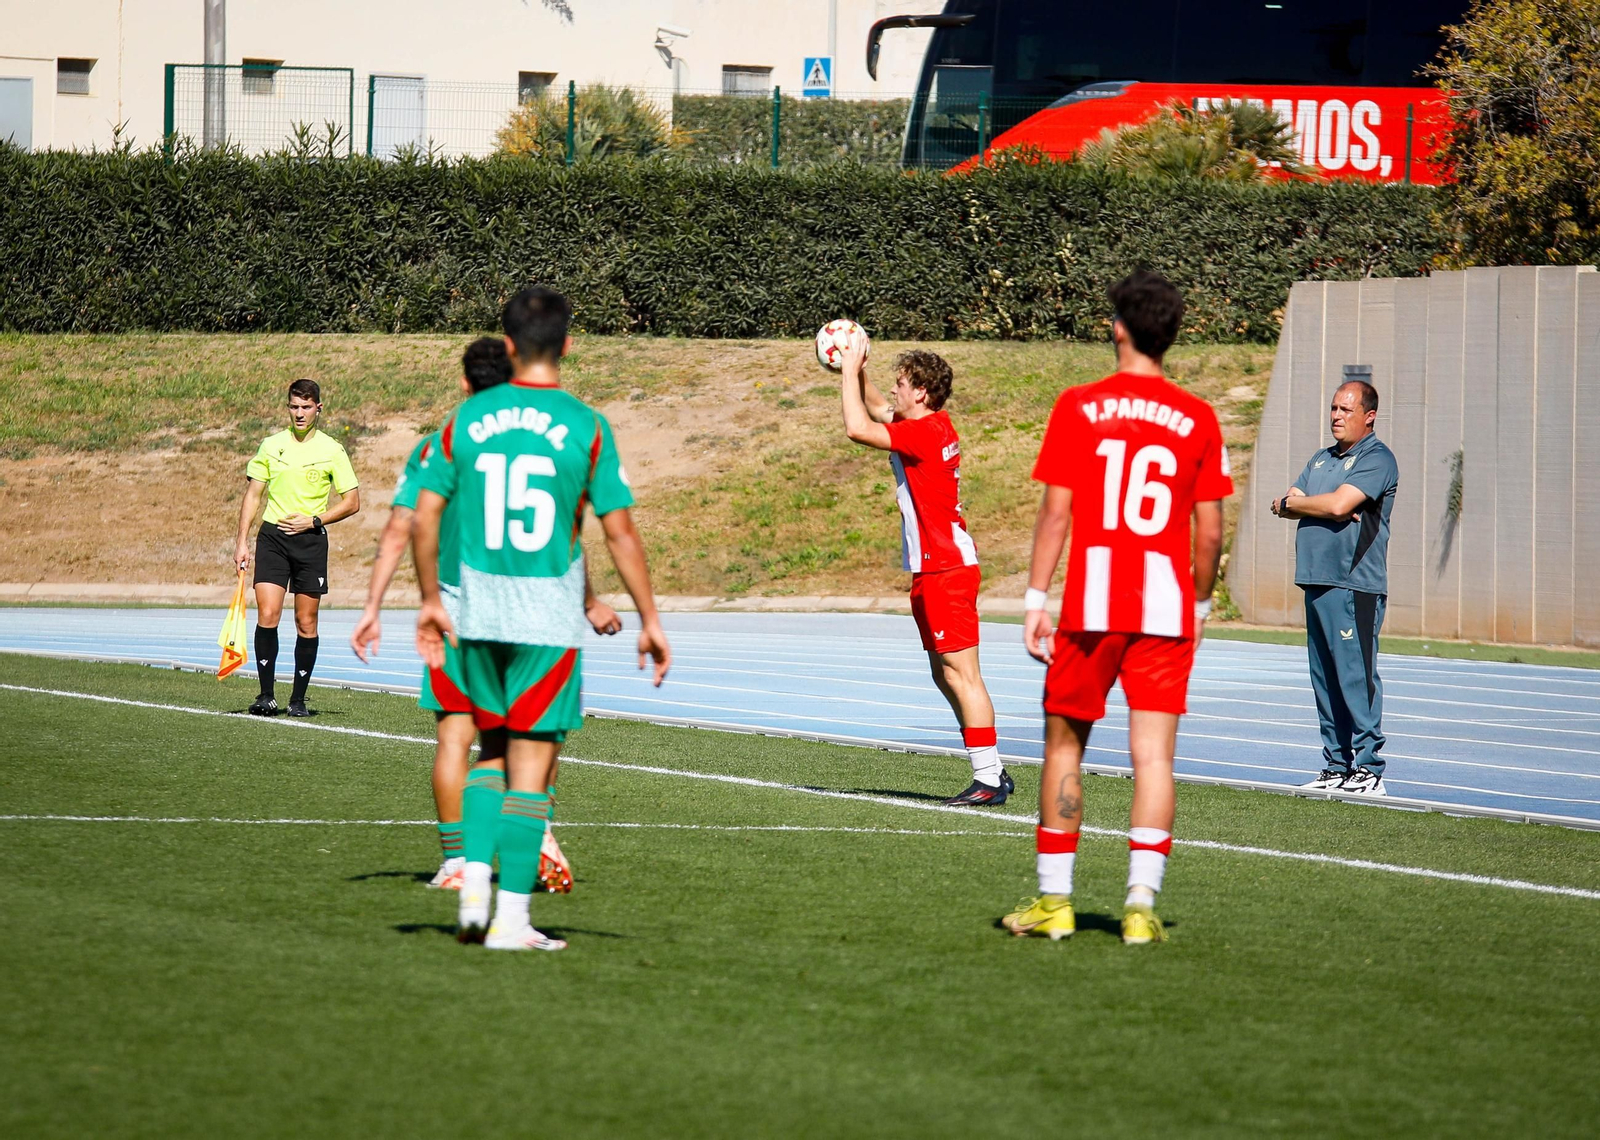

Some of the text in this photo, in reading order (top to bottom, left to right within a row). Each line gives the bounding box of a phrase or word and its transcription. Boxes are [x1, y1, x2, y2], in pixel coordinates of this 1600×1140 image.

[469, 406, 552, 444] CARLOS
[1082, 398, 1195, 437] Y.PAREDES
[474, 453, 557, 552] 15
[1095, 438, 1178, 536] 16
